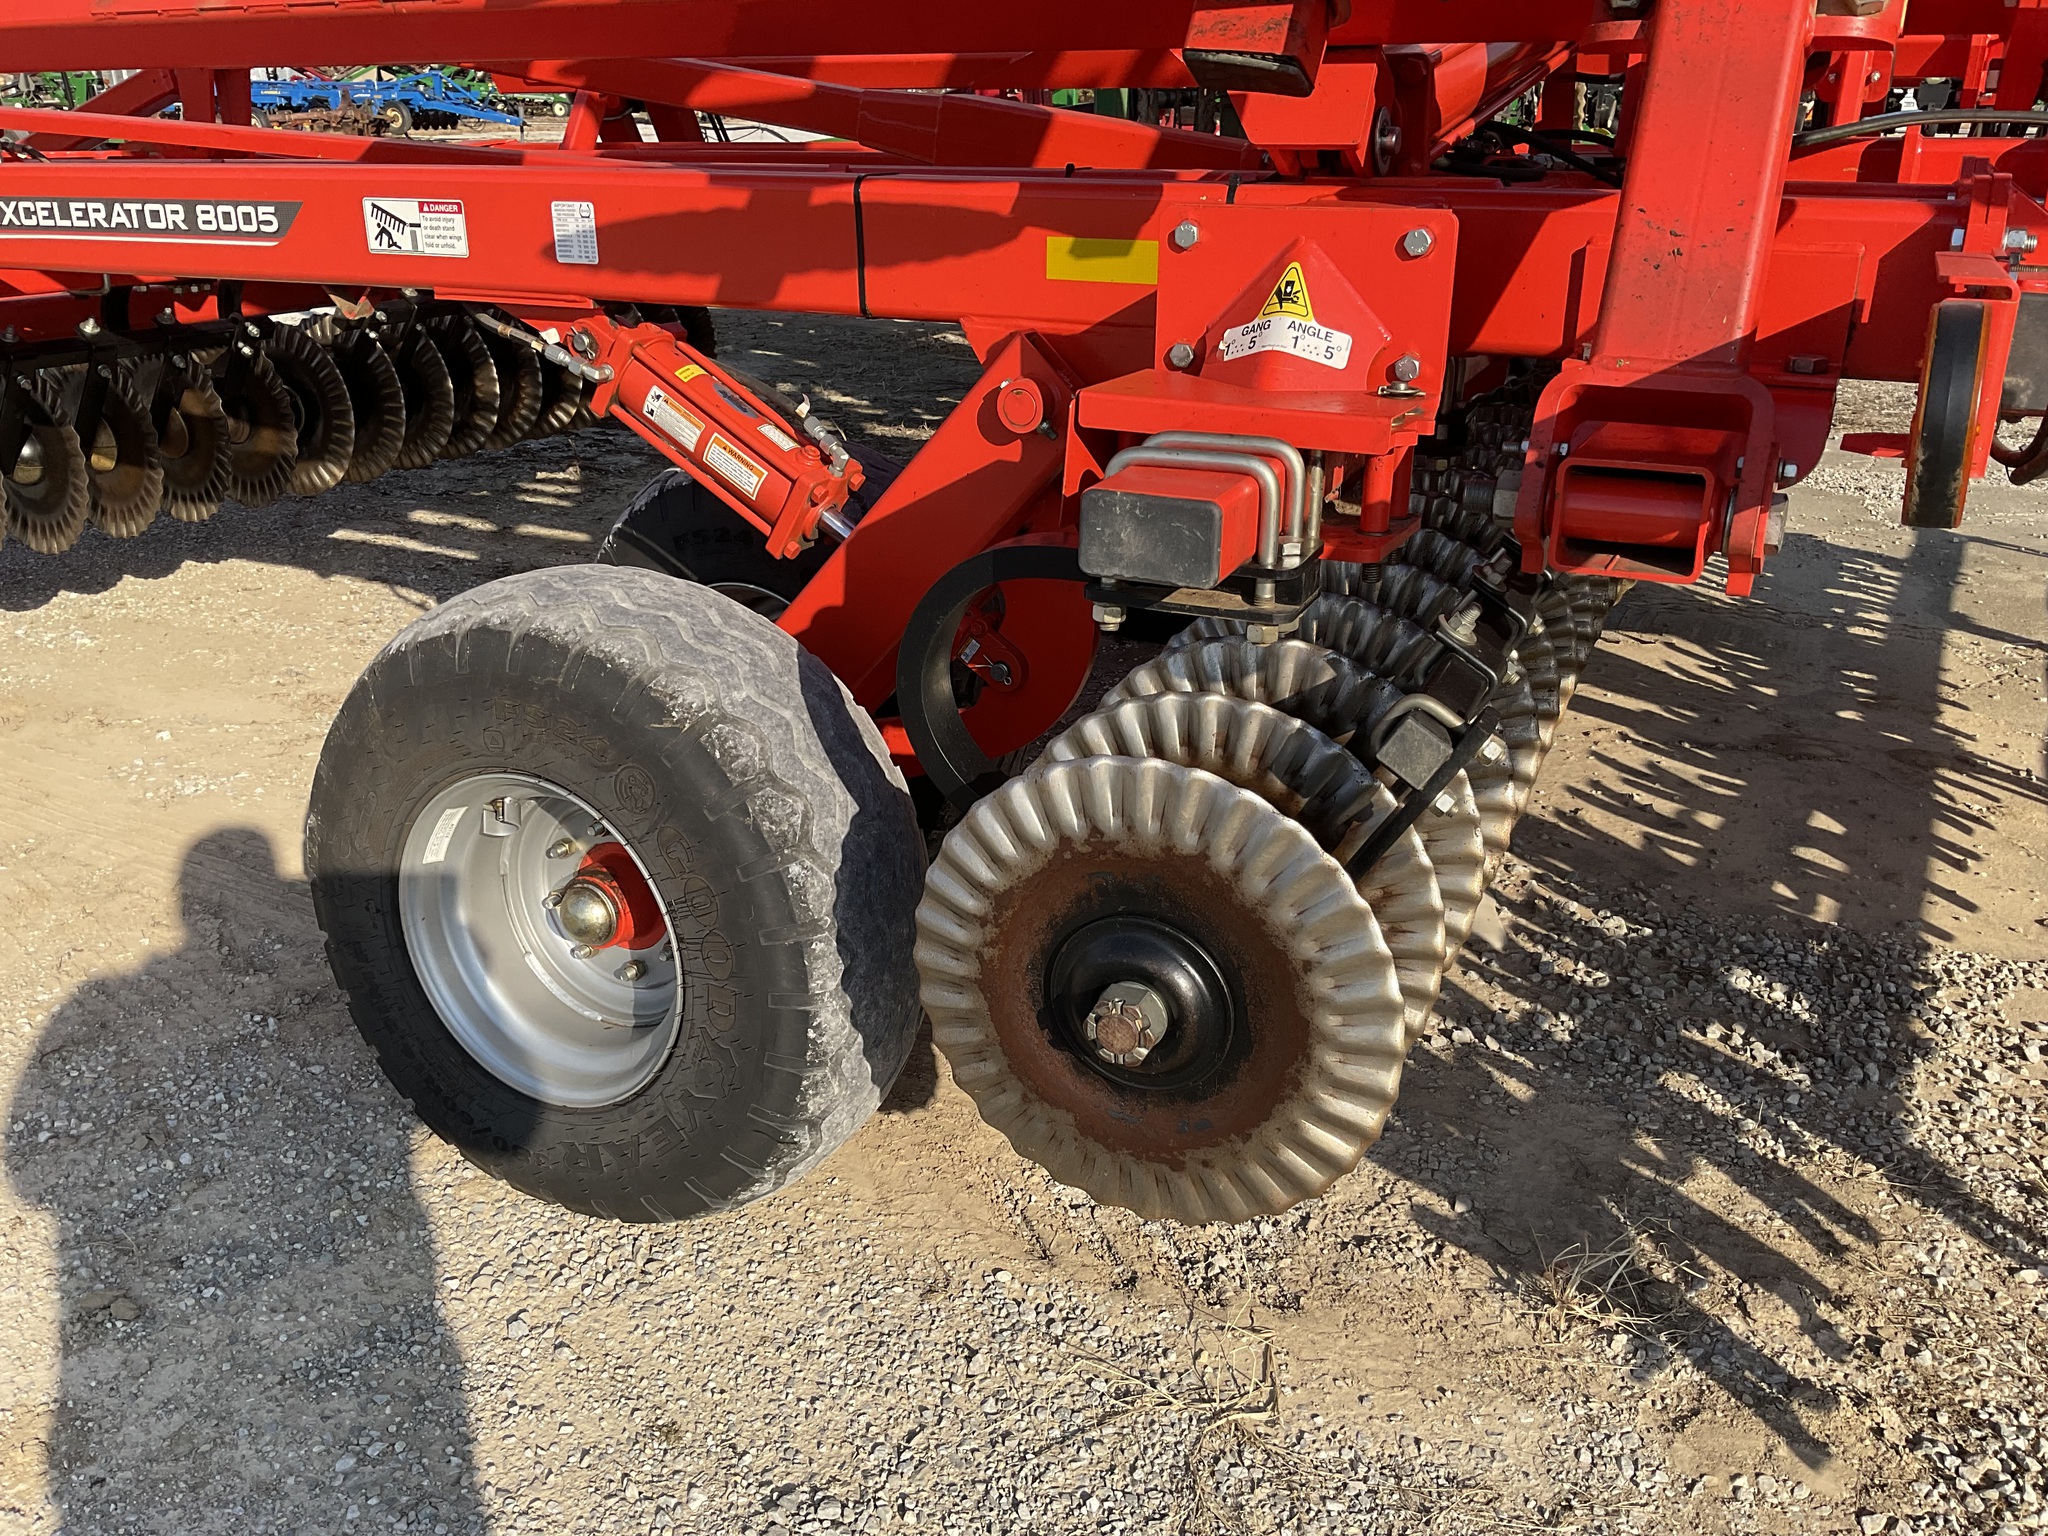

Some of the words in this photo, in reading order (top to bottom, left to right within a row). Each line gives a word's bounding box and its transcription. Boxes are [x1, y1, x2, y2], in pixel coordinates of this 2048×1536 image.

[0, 200, 189, 231] XCELERATOR
[195, 204, 279, 233] 8005
[430, 203, 458, 212] DANGER
[1241, 320, 1272, 336] GANG
[1287, 320, 1334, 343] ANGLE
[728, 449, 754, 471] WARNING
[494, 698, 612, 764] FS24
[561, 825, 739, 1175] GOODYEAR
